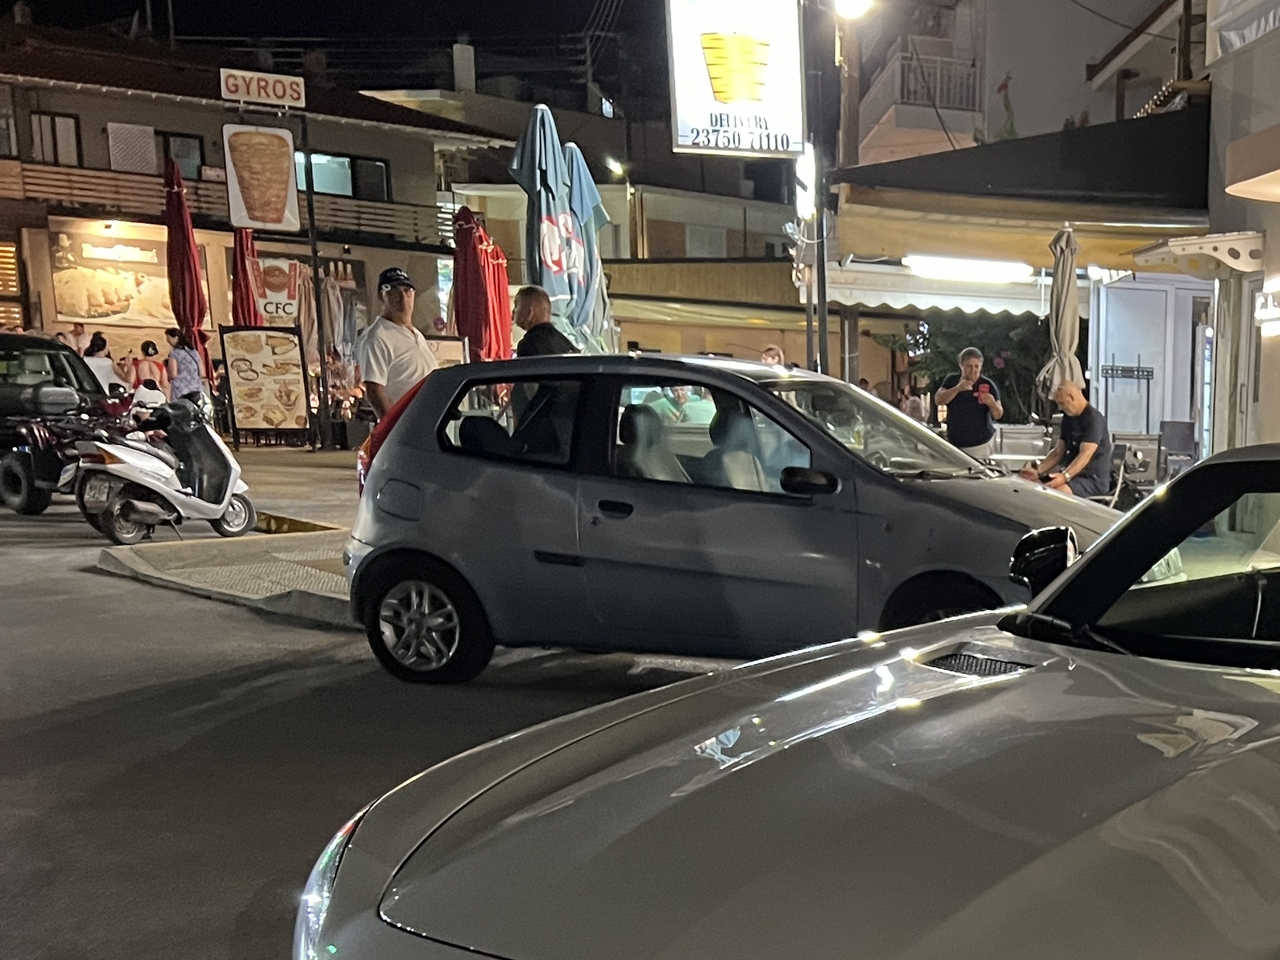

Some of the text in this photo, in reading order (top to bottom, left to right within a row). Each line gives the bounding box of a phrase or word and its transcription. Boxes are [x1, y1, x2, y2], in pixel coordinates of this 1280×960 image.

[225, 73, 301, 101] GYROS
[690, 127, 741, 149] 23750
[263, 301, 294, 315] CFC
